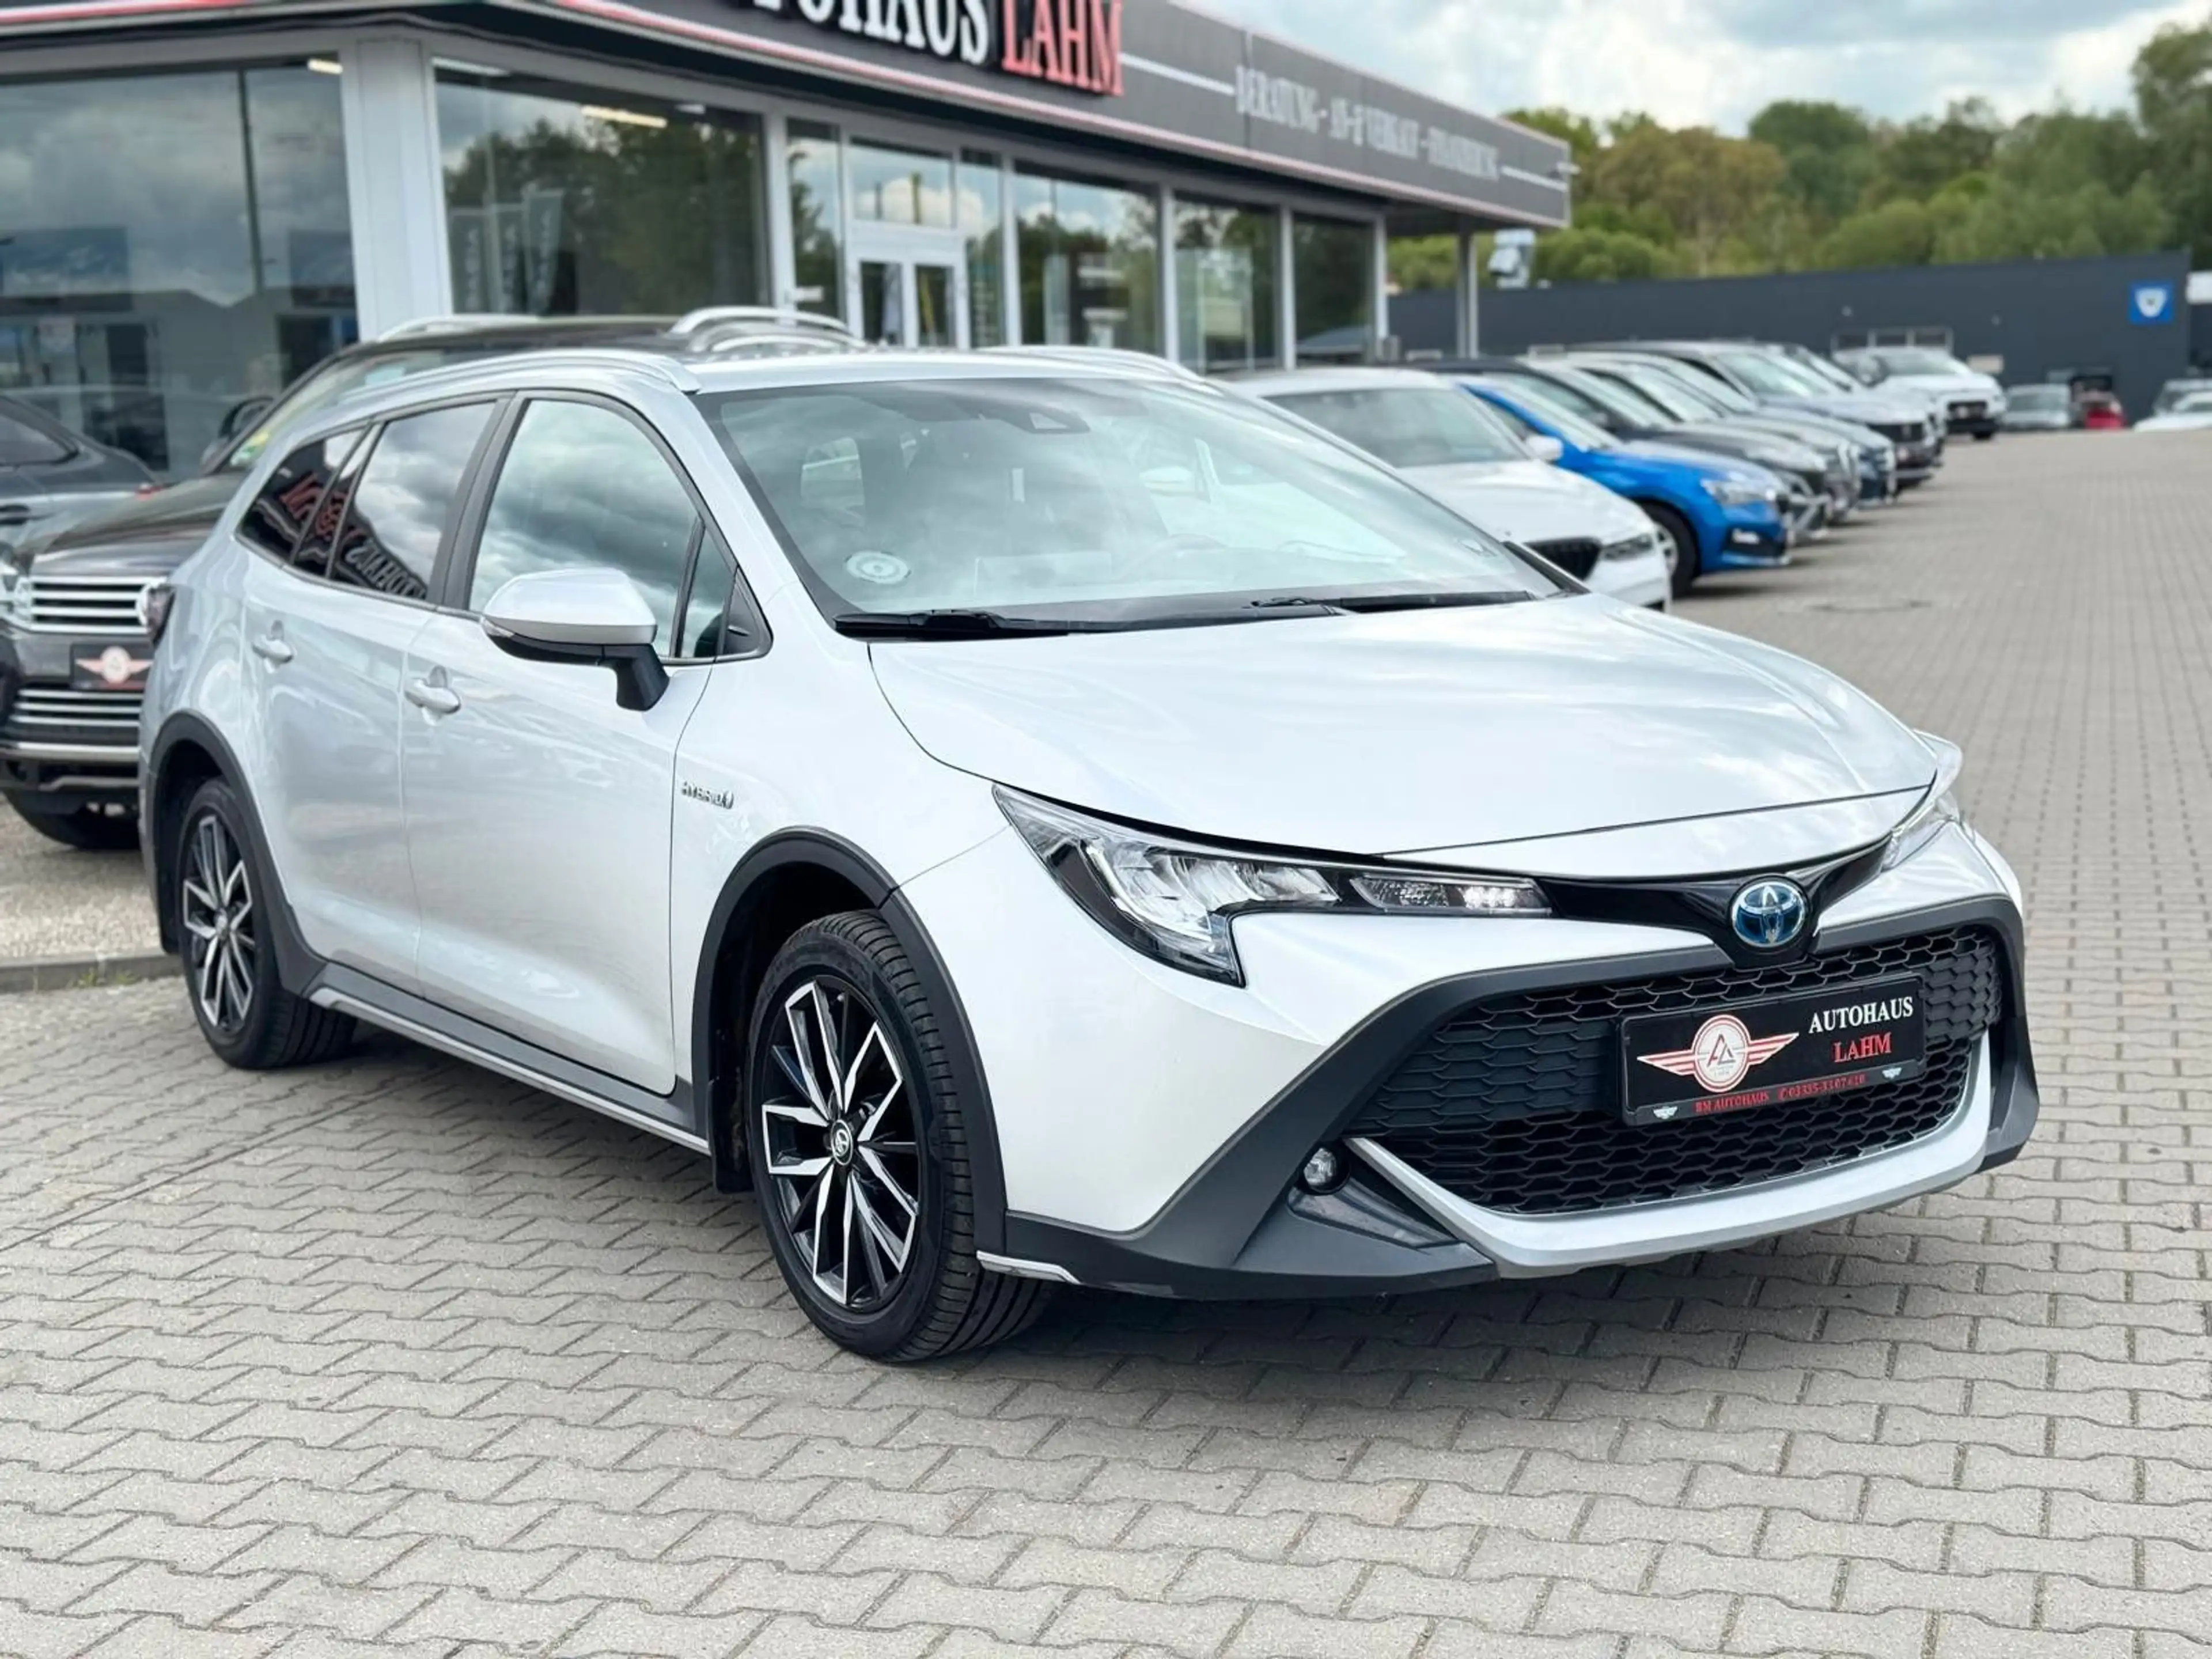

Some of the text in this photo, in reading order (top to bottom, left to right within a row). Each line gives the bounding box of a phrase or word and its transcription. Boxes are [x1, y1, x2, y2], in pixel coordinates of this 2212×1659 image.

[1002, 0, 1123, 97] LAHM
[1808, 996, 1914, 1034] AUTOHAUS
[1834, 1032, 1892, 1063] LAHM
[1714, 1090, 1770, 1111] AUTOHAUS
